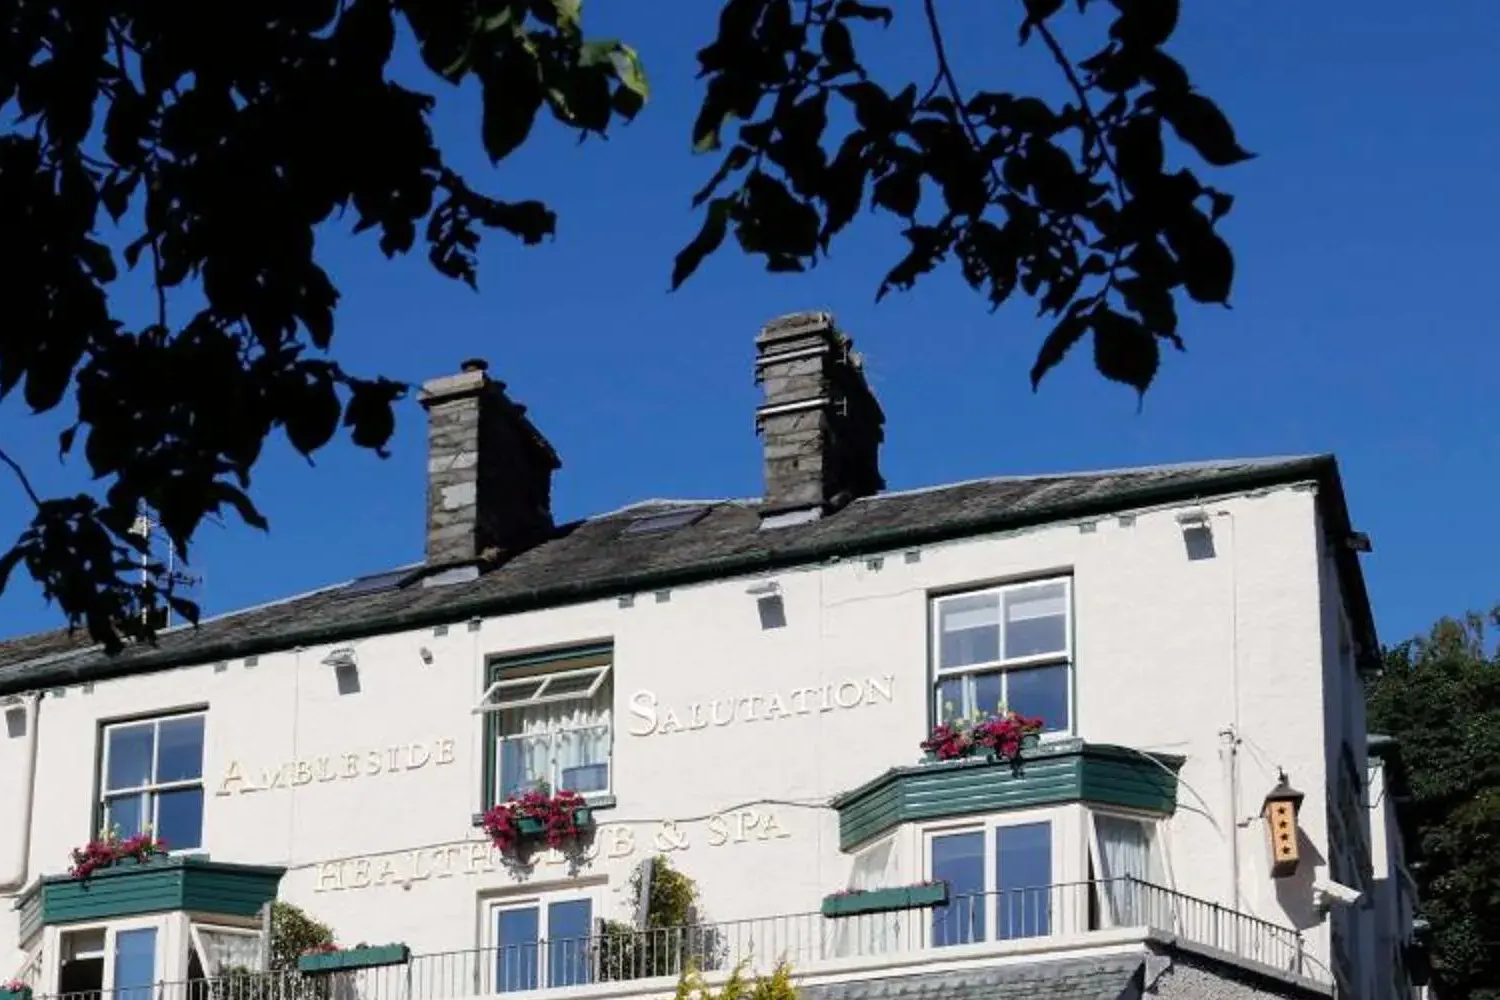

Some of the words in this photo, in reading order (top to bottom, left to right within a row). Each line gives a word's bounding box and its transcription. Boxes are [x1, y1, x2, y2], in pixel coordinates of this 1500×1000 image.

[215, 737, 456, 797] AMBLESIDE
[628, 674, 896, 737] SALUTATION
[313, 843, 499, 893] HEALTH
[653, 818, 691, 852] &
[707, 808, 791, 847] SPA
